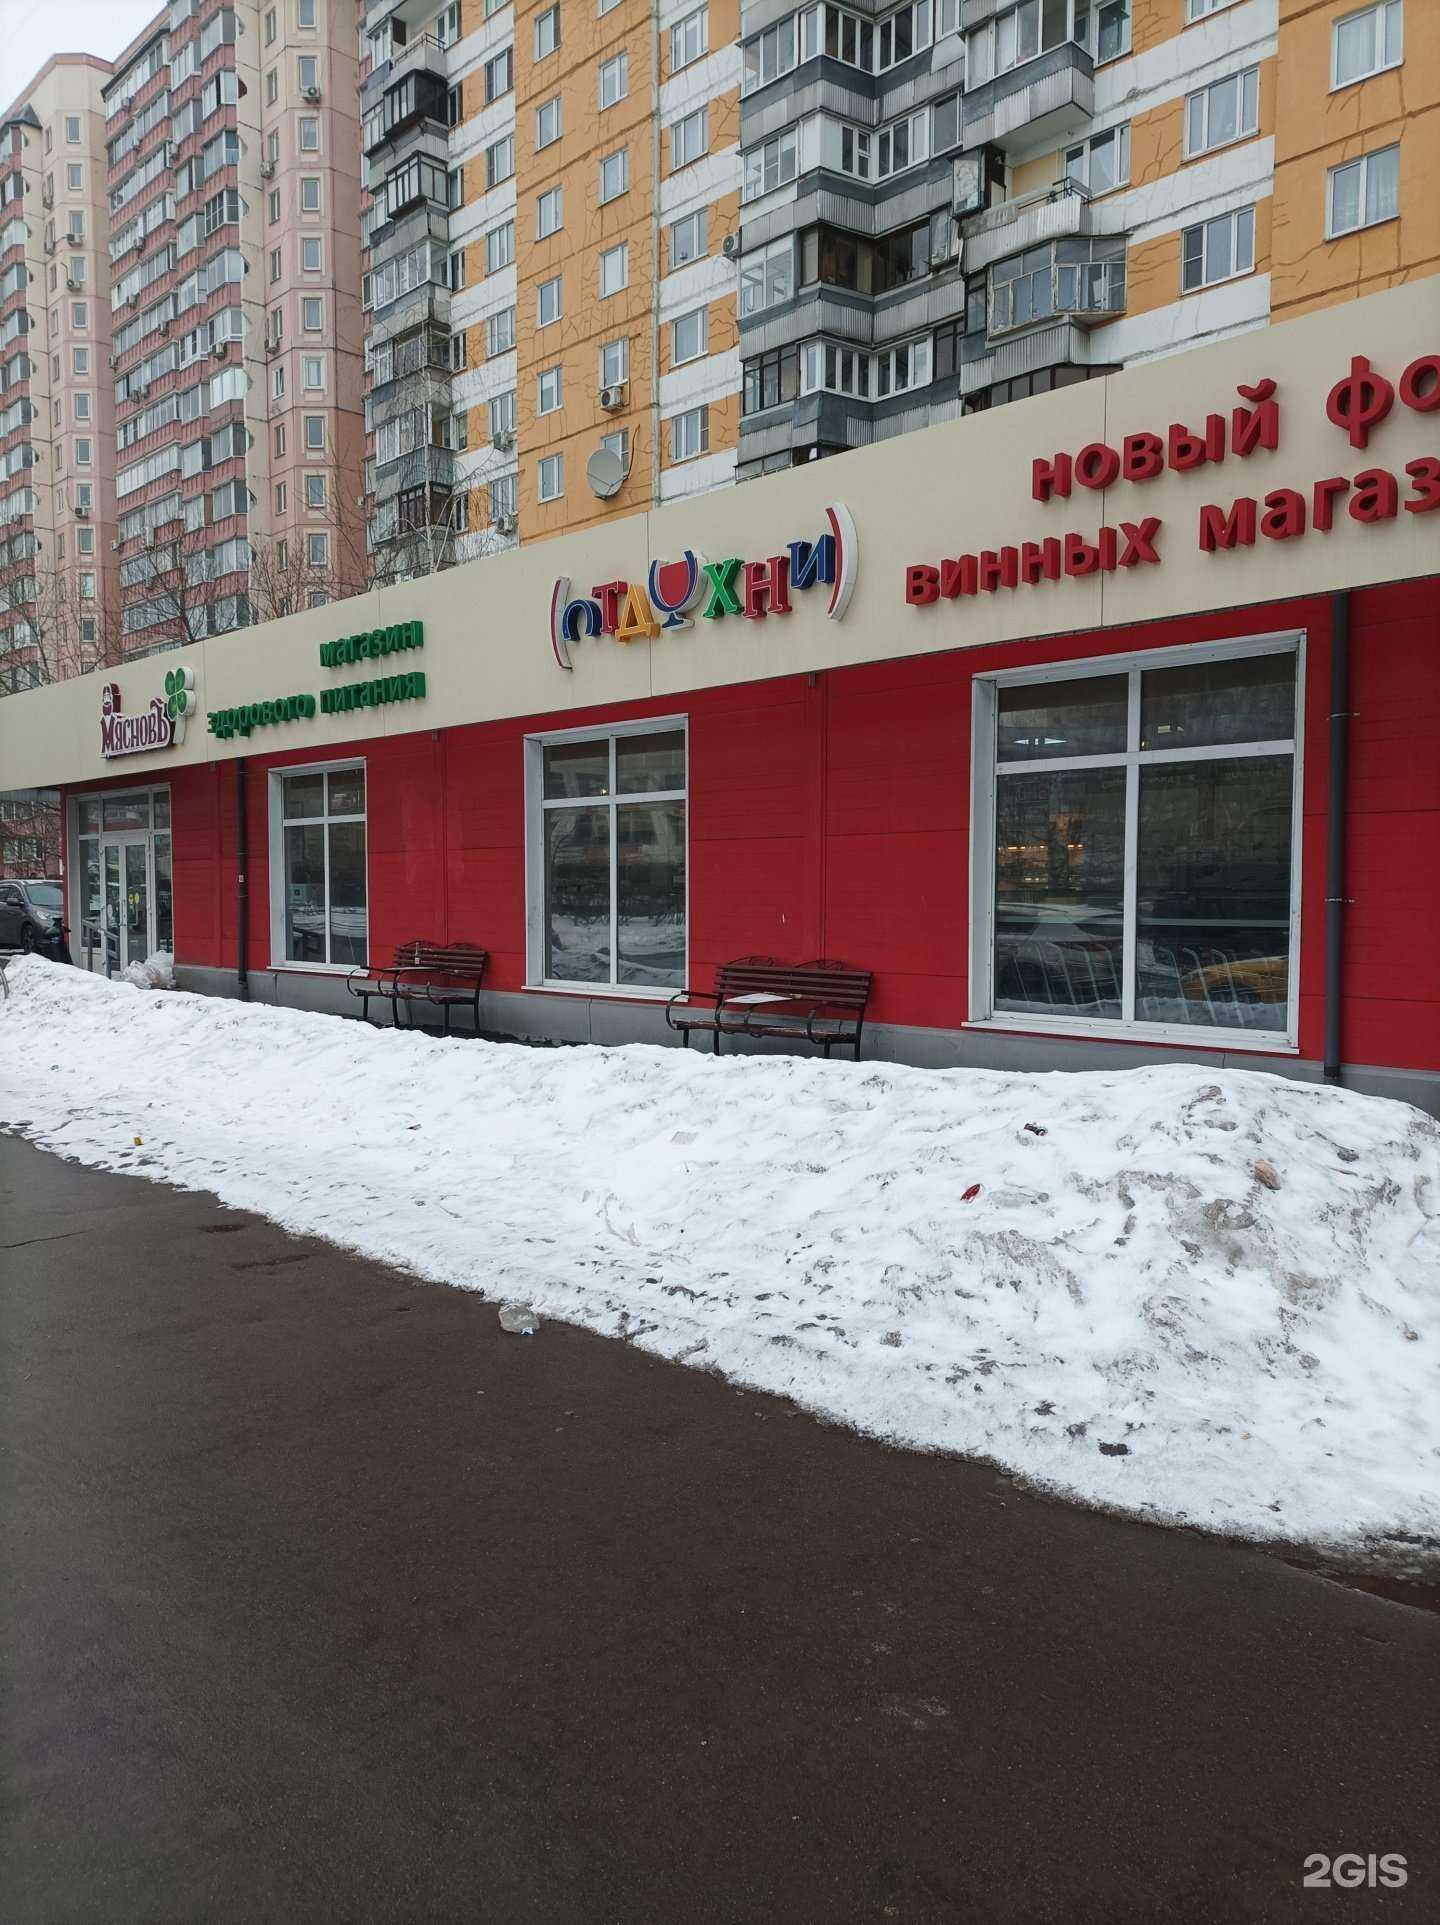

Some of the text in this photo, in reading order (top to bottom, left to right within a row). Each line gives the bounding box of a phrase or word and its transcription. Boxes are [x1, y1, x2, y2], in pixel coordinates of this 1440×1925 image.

[1032, 355, 1440, 502] новый фо
[906, 457, 1440, 606] винных магаз
[320, 621, 424, 667] магазин
[207, 672, 426, 738] здорового питания
